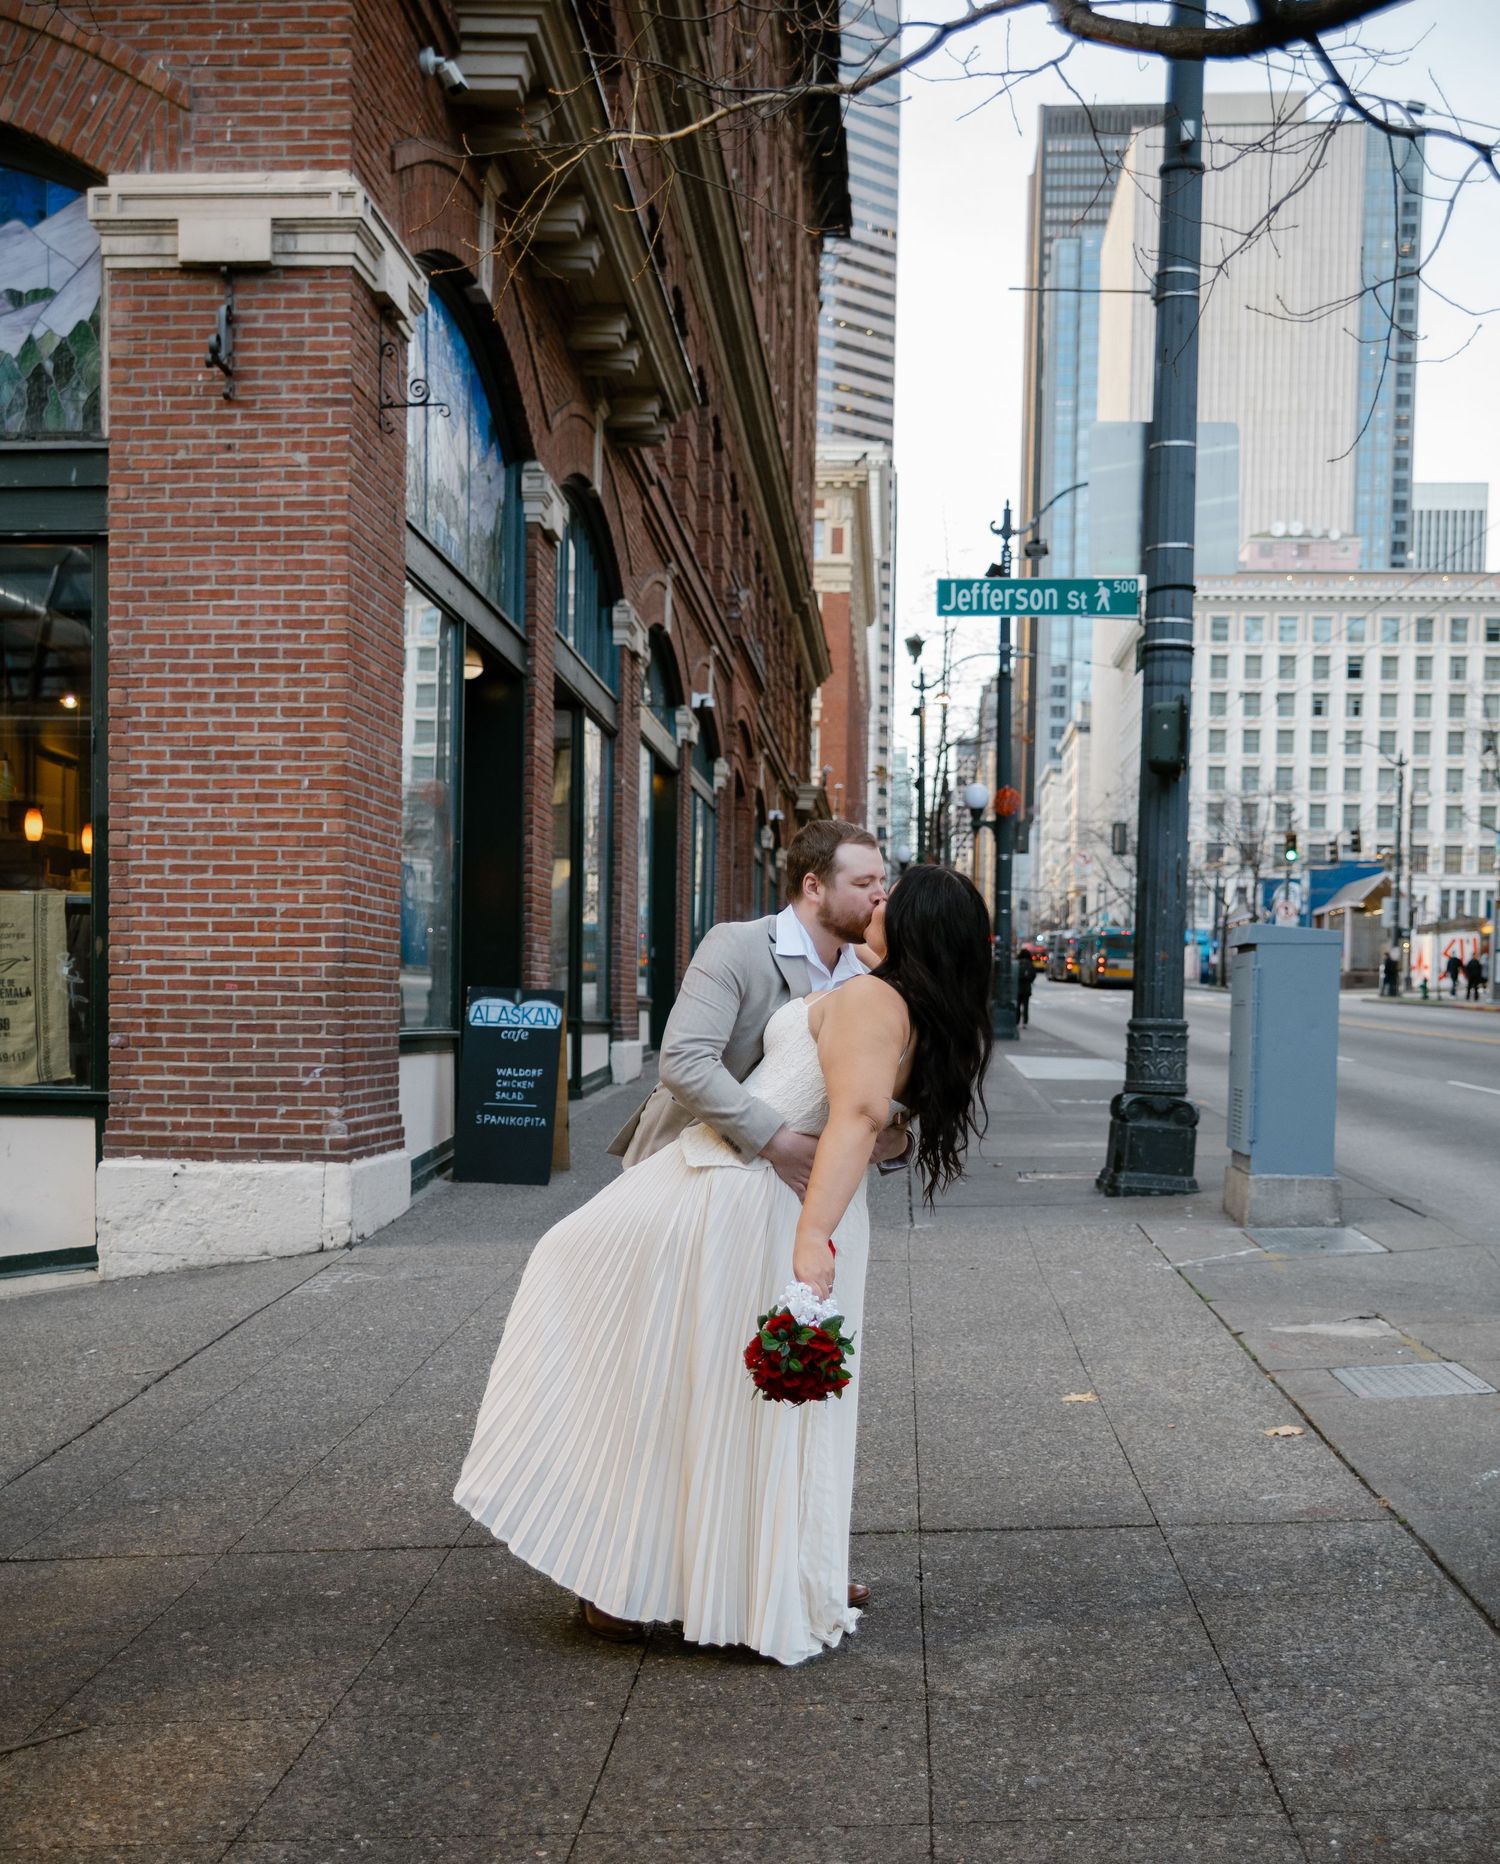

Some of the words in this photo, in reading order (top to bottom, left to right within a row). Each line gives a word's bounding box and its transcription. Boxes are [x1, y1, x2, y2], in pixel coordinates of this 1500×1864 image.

[942, 581, 1059, 612] Jefferson
[1066, 590, 1088, 611] St
[1113, 580, 1137, 594] 500
[472, 1005, 559, 1026] ALASKAN
[501, 1029, 530, 1042] cafe
[496, 1068, 543, 1078] WALDORF
[496, 1079, 534, 1089] CHICKEN
[495, 1091, 524, 1101] SALAD
[476, 1114, 546, 1127] SPANIKOPITA
